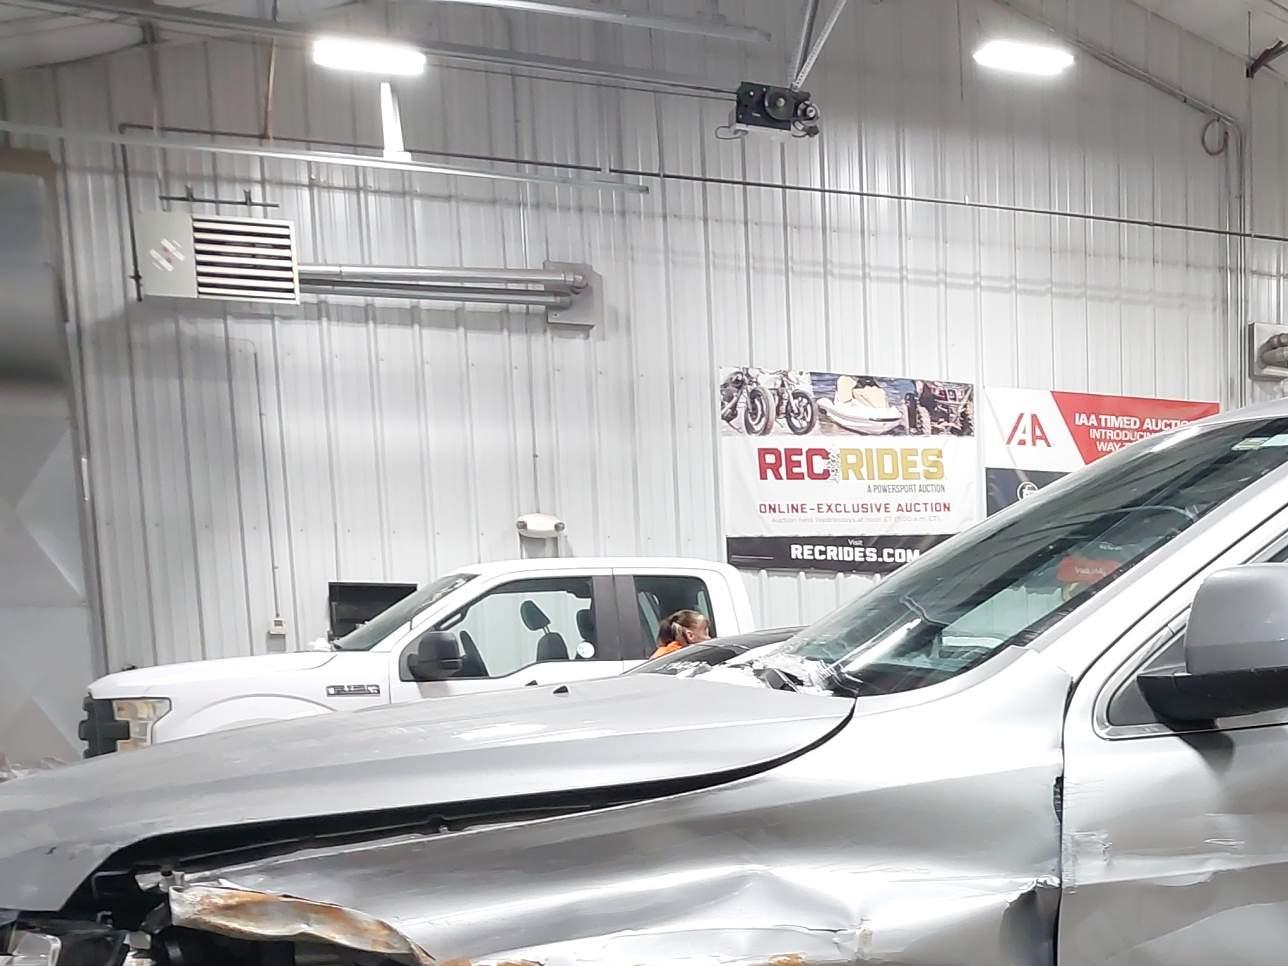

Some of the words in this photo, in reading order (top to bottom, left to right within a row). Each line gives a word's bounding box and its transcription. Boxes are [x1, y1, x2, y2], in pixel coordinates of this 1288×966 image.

[1075, 413, 1098, 427] IAA
[1099, 415, 1140, 429] TIMED
[1096, 441, 1120, 451] WAY
[757, 447, 831, 481] REC
[839, 447, 945, 481] RIDES
[866, 484, 873, 493] A
[873, 484, 917, 494] POWERSPORT
[918, 484, 946, 493] AUCTION
[759, 502, 891, 514] ONLINE-EXCLUSIVE
[896, 502, 952, 513] AUCTION
[847, 538, 863, 546] Visit
[790, 544, 921, 563] RECRIDES.COM
